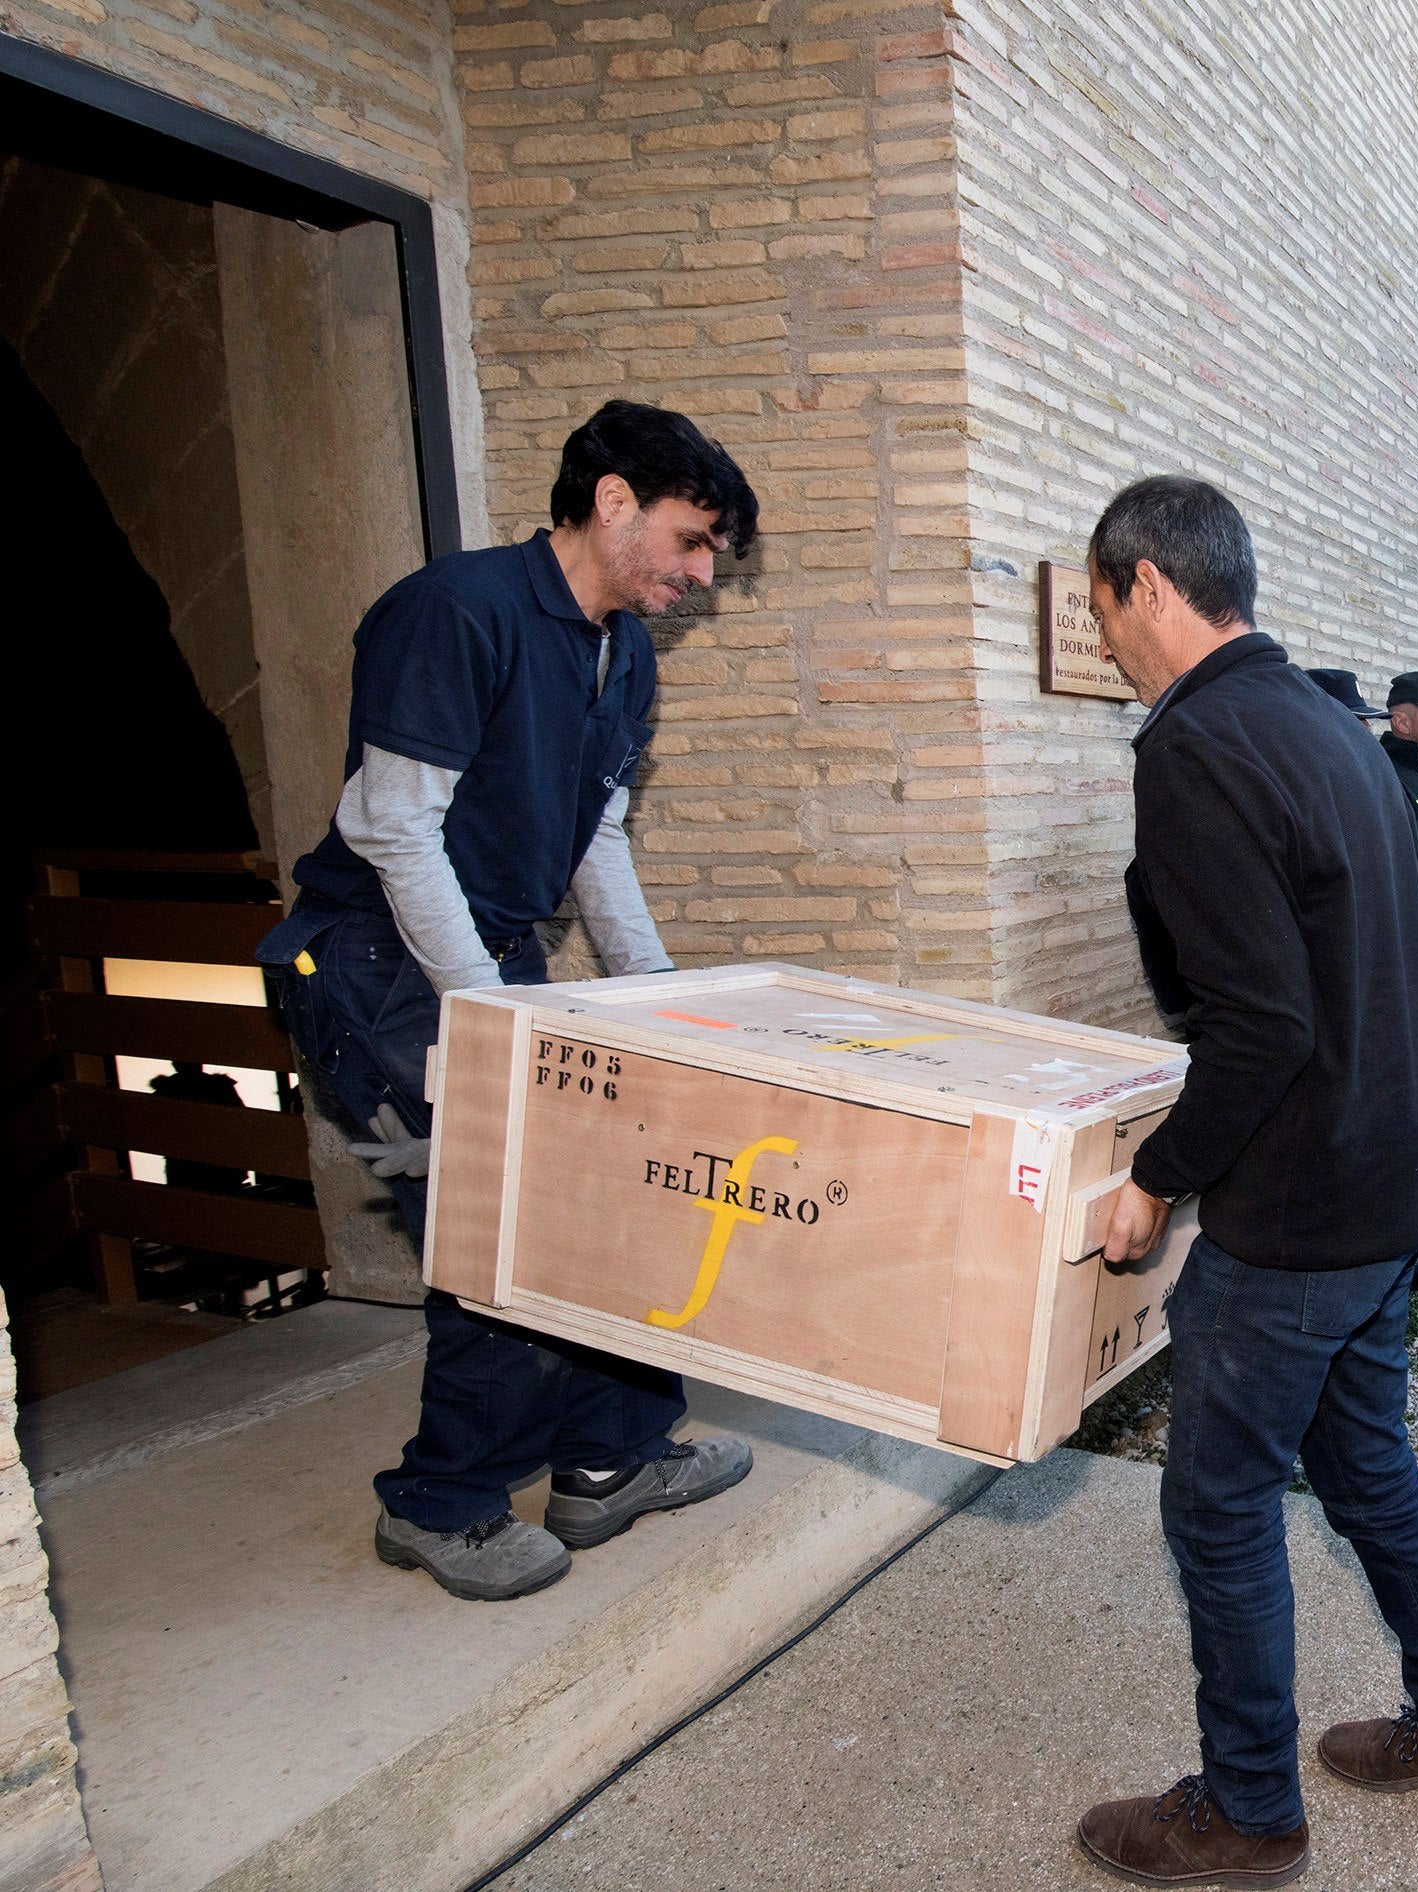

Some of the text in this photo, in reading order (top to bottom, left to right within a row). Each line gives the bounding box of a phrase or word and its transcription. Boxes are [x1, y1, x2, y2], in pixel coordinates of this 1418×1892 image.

[1067, 592, 1090, 608] ENT
[1056, 613, 1076, 630] LOS
[603, 776, 618, 789] Qu
[644, 1151, 820, 1225] FELTRERO
